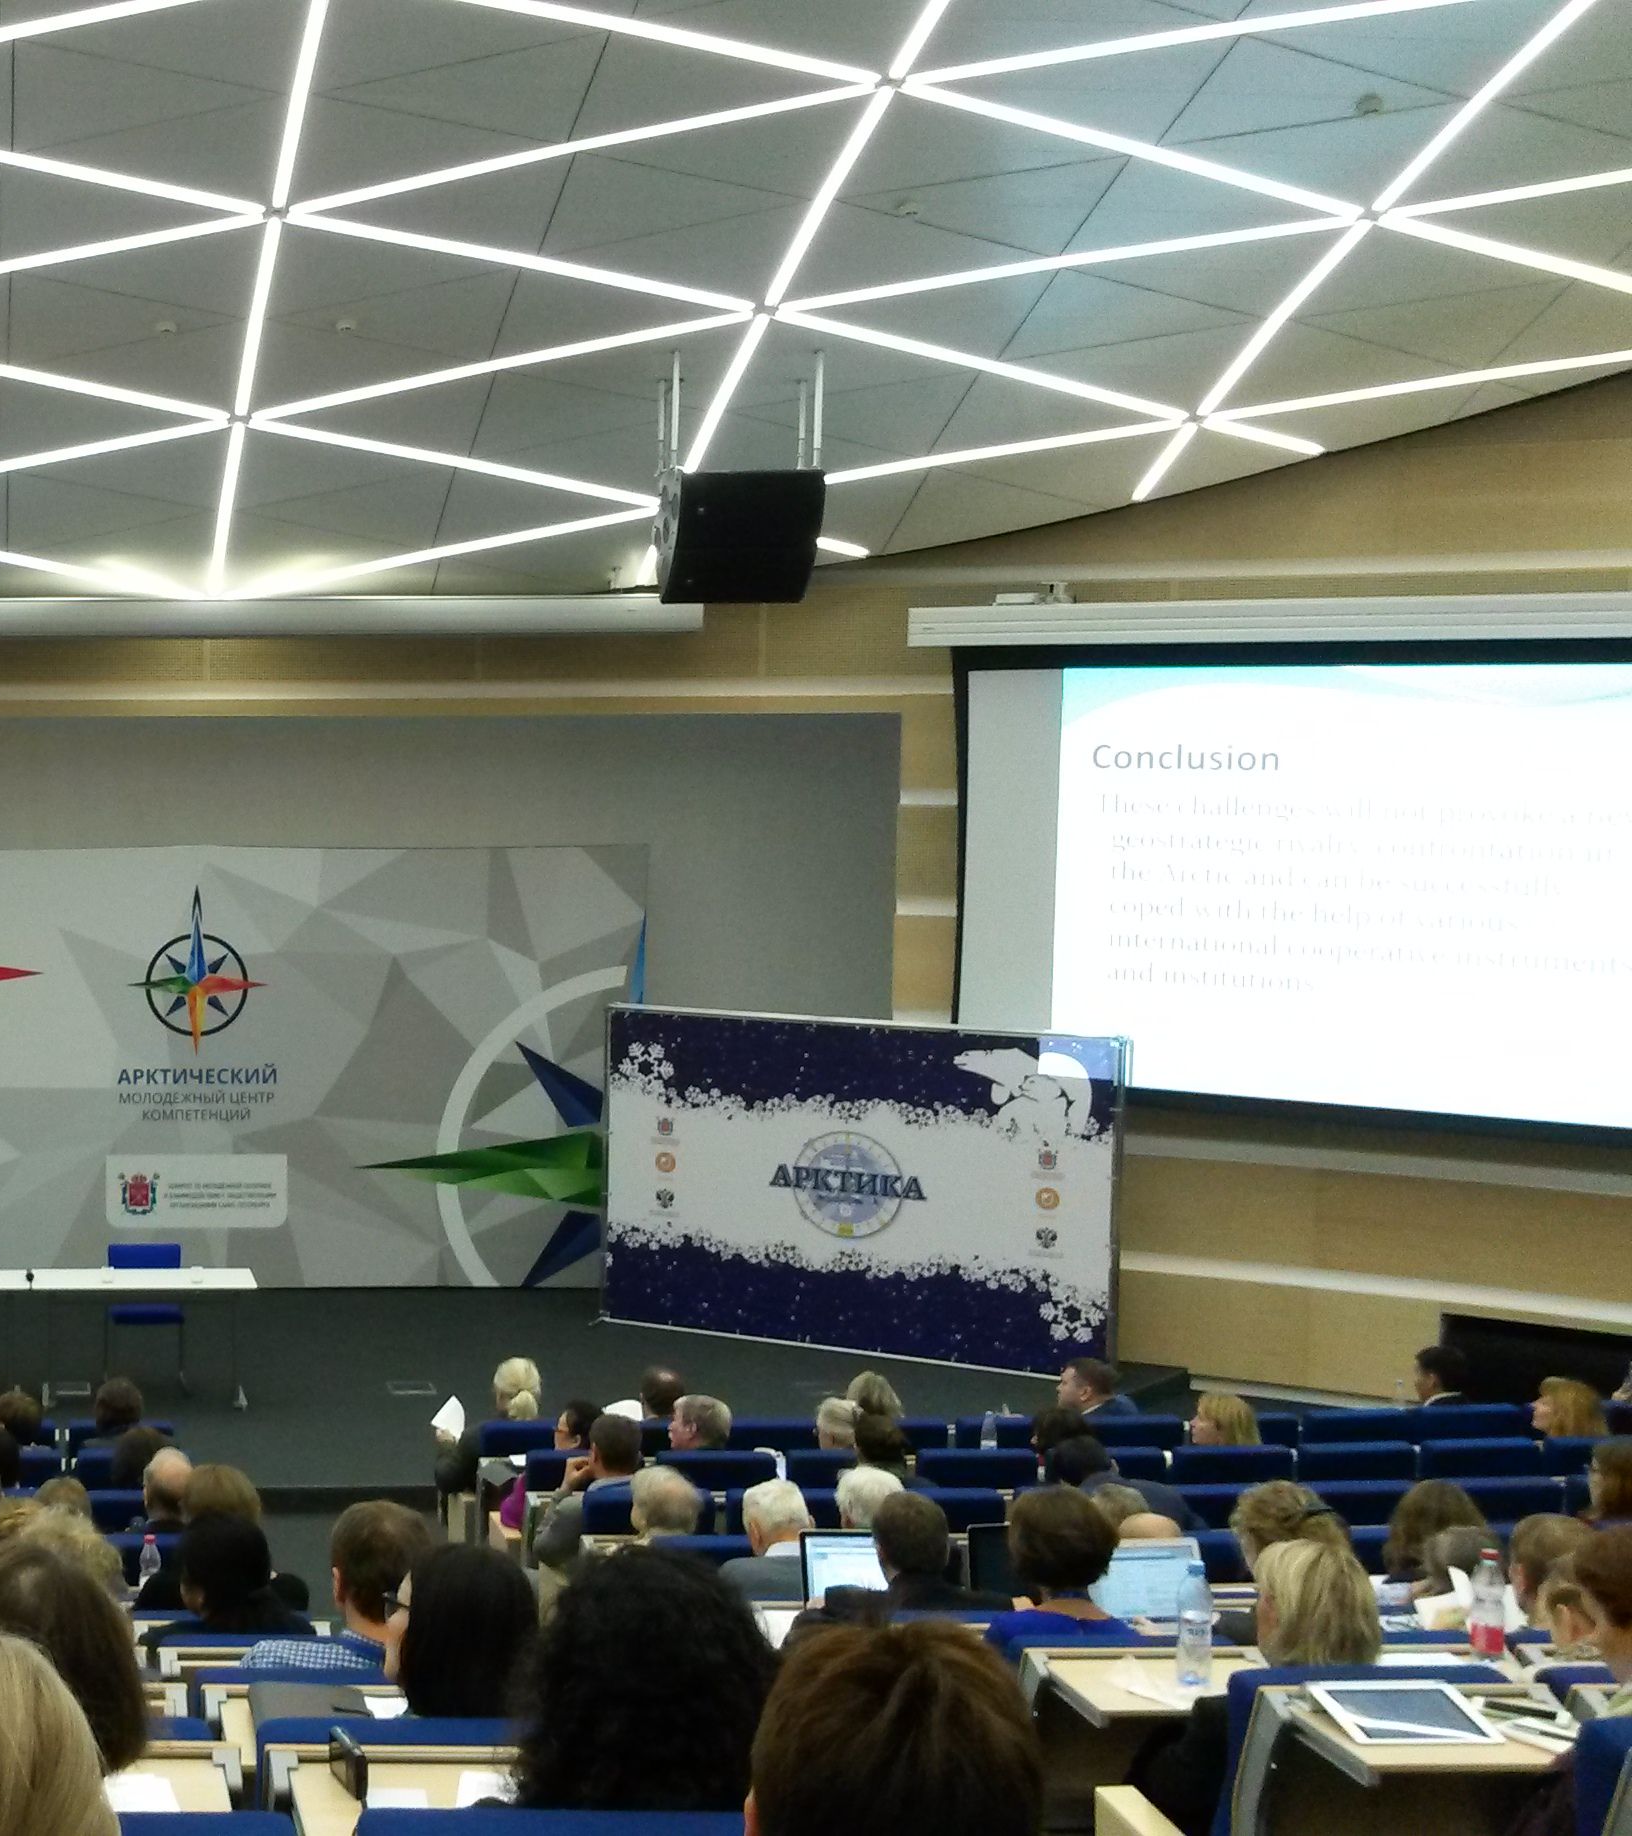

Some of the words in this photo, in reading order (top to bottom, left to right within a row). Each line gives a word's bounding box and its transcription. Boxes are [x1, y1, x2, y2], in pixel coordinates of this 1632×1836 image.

[1092, 743, 1280, 771] Conclusion
[117, 1063, 278, 1085] АРКТИЧЕСКИЙ
[118, 1088, 226, 1107] МОЛОДЕЖНЫЙ
[229, 1090, 275, 1107] ЦЕНТР
[142, 1107, 252, 1123] КОМПЕТЕНЦИЙ
[769, 1163, 928, 1202] АРКТИКА
